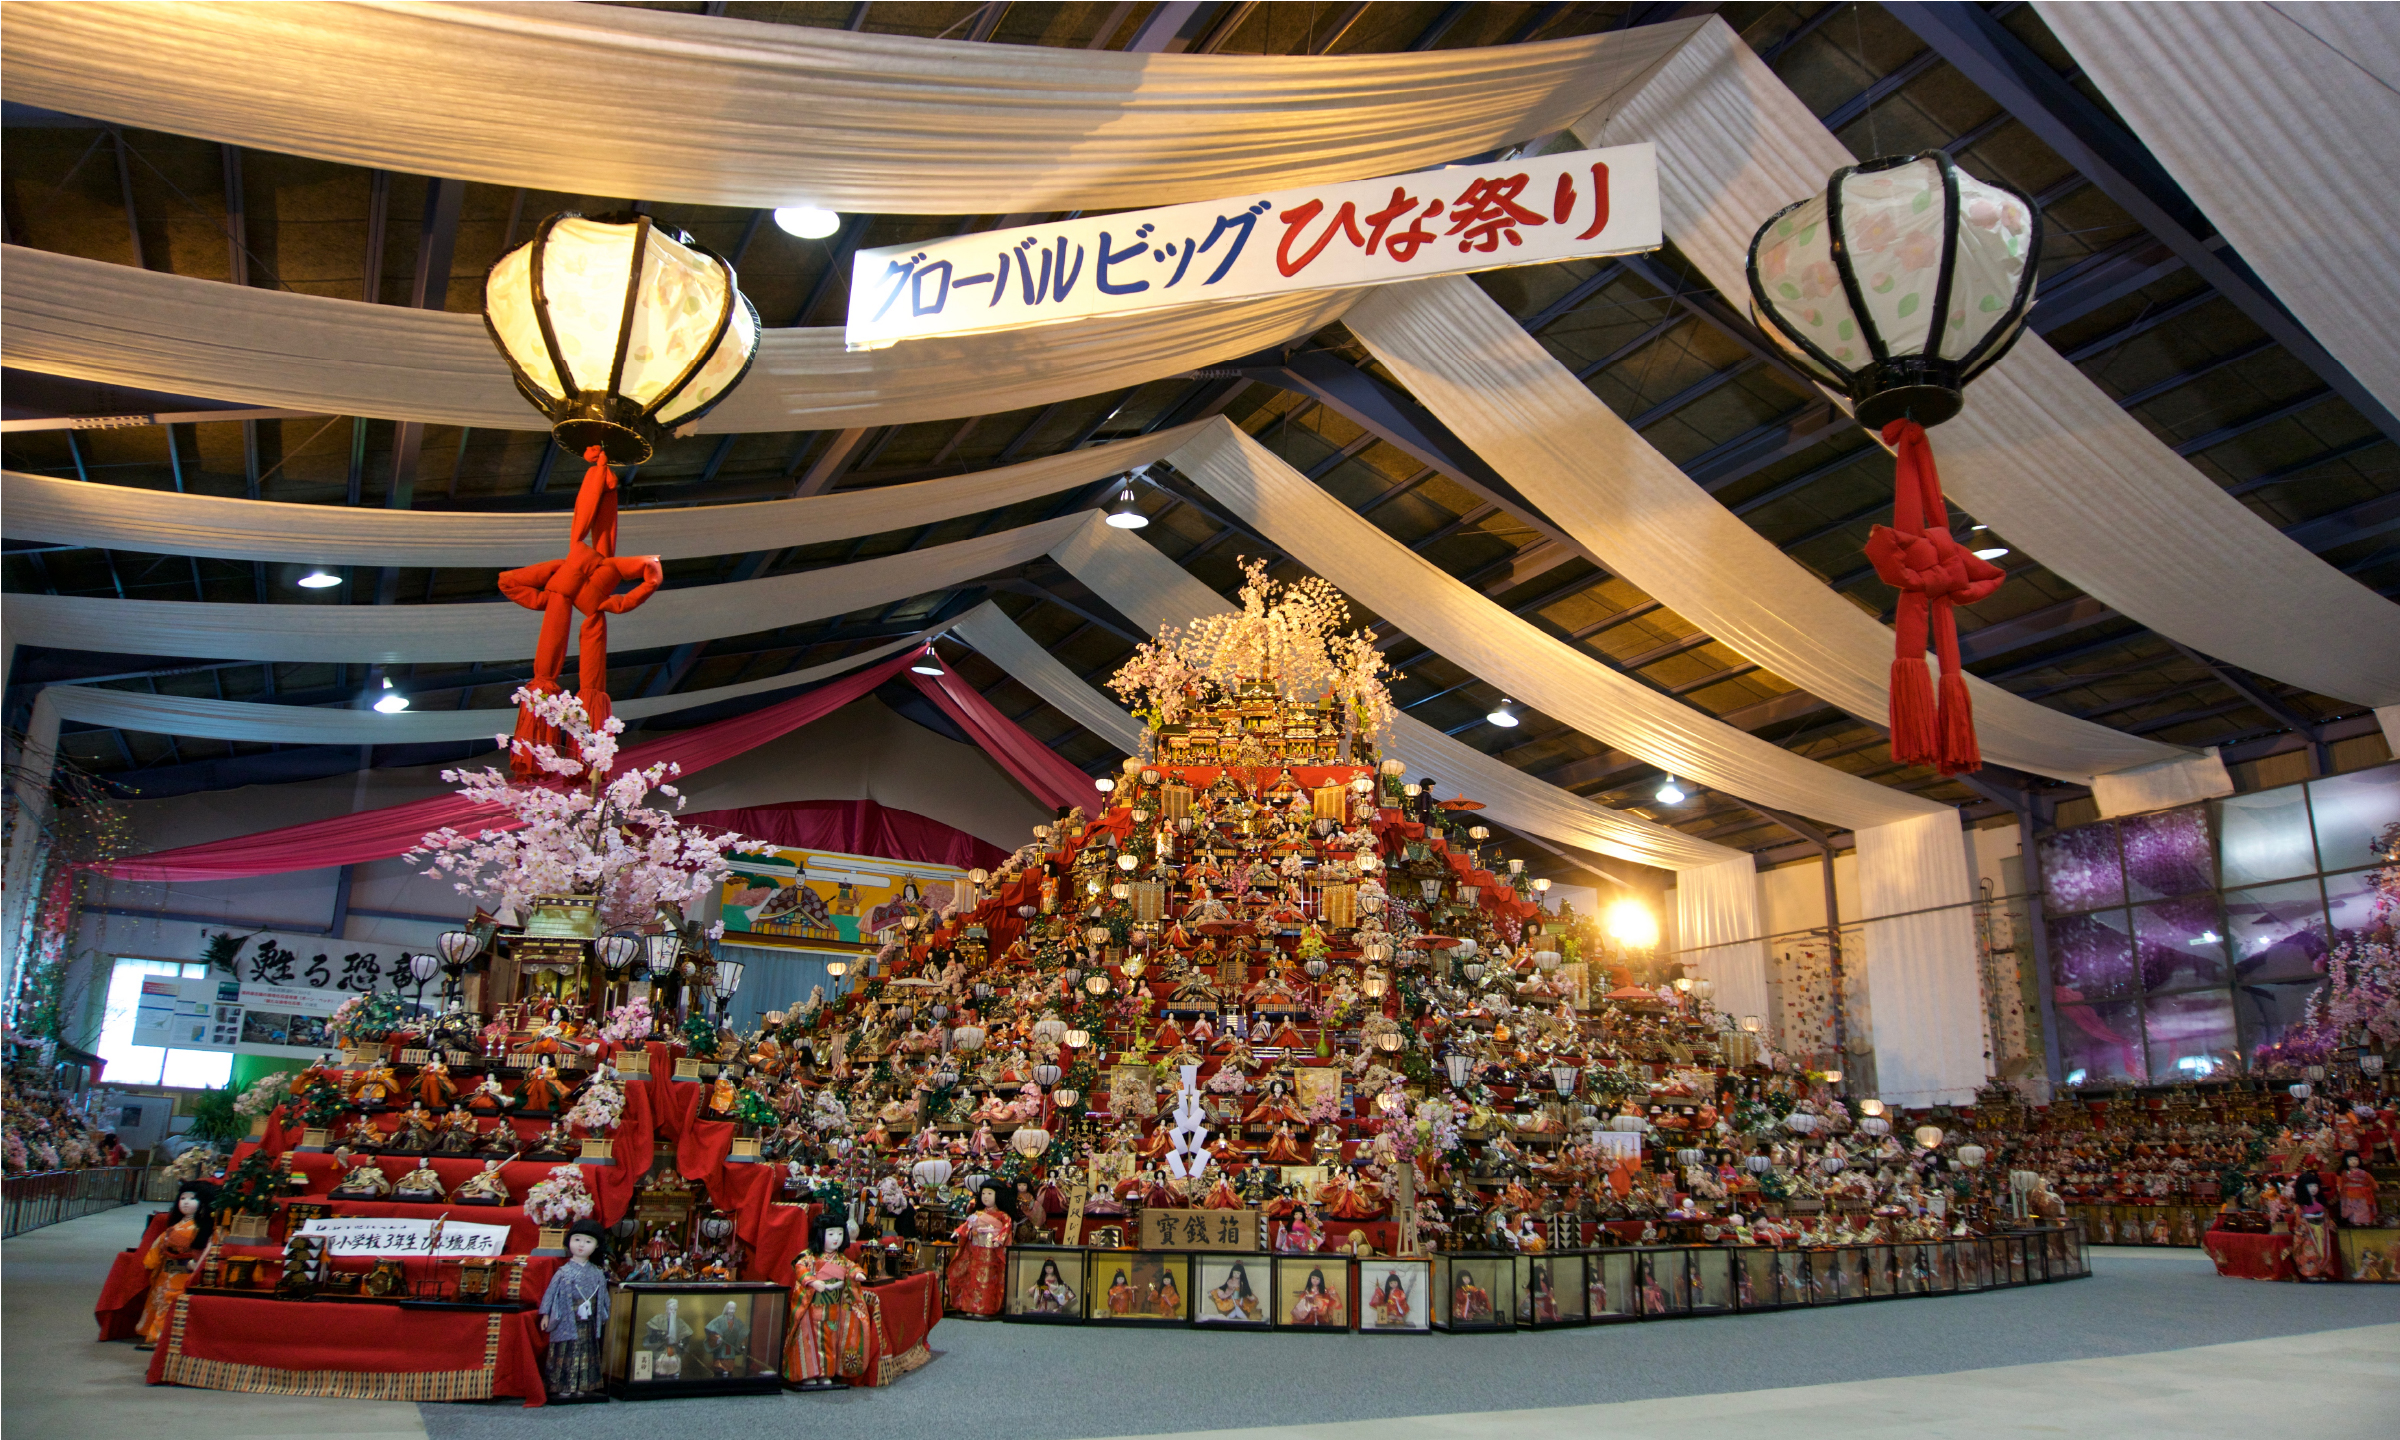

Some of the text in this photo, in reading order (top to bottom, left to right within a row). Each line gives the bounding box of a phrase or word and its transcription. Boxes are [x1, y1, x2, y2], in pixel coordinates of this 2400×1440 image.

[871, 162, 1610, 322] グローバルビッグひな祭り
[250, 939, 464, 998] 甦る恐竜
